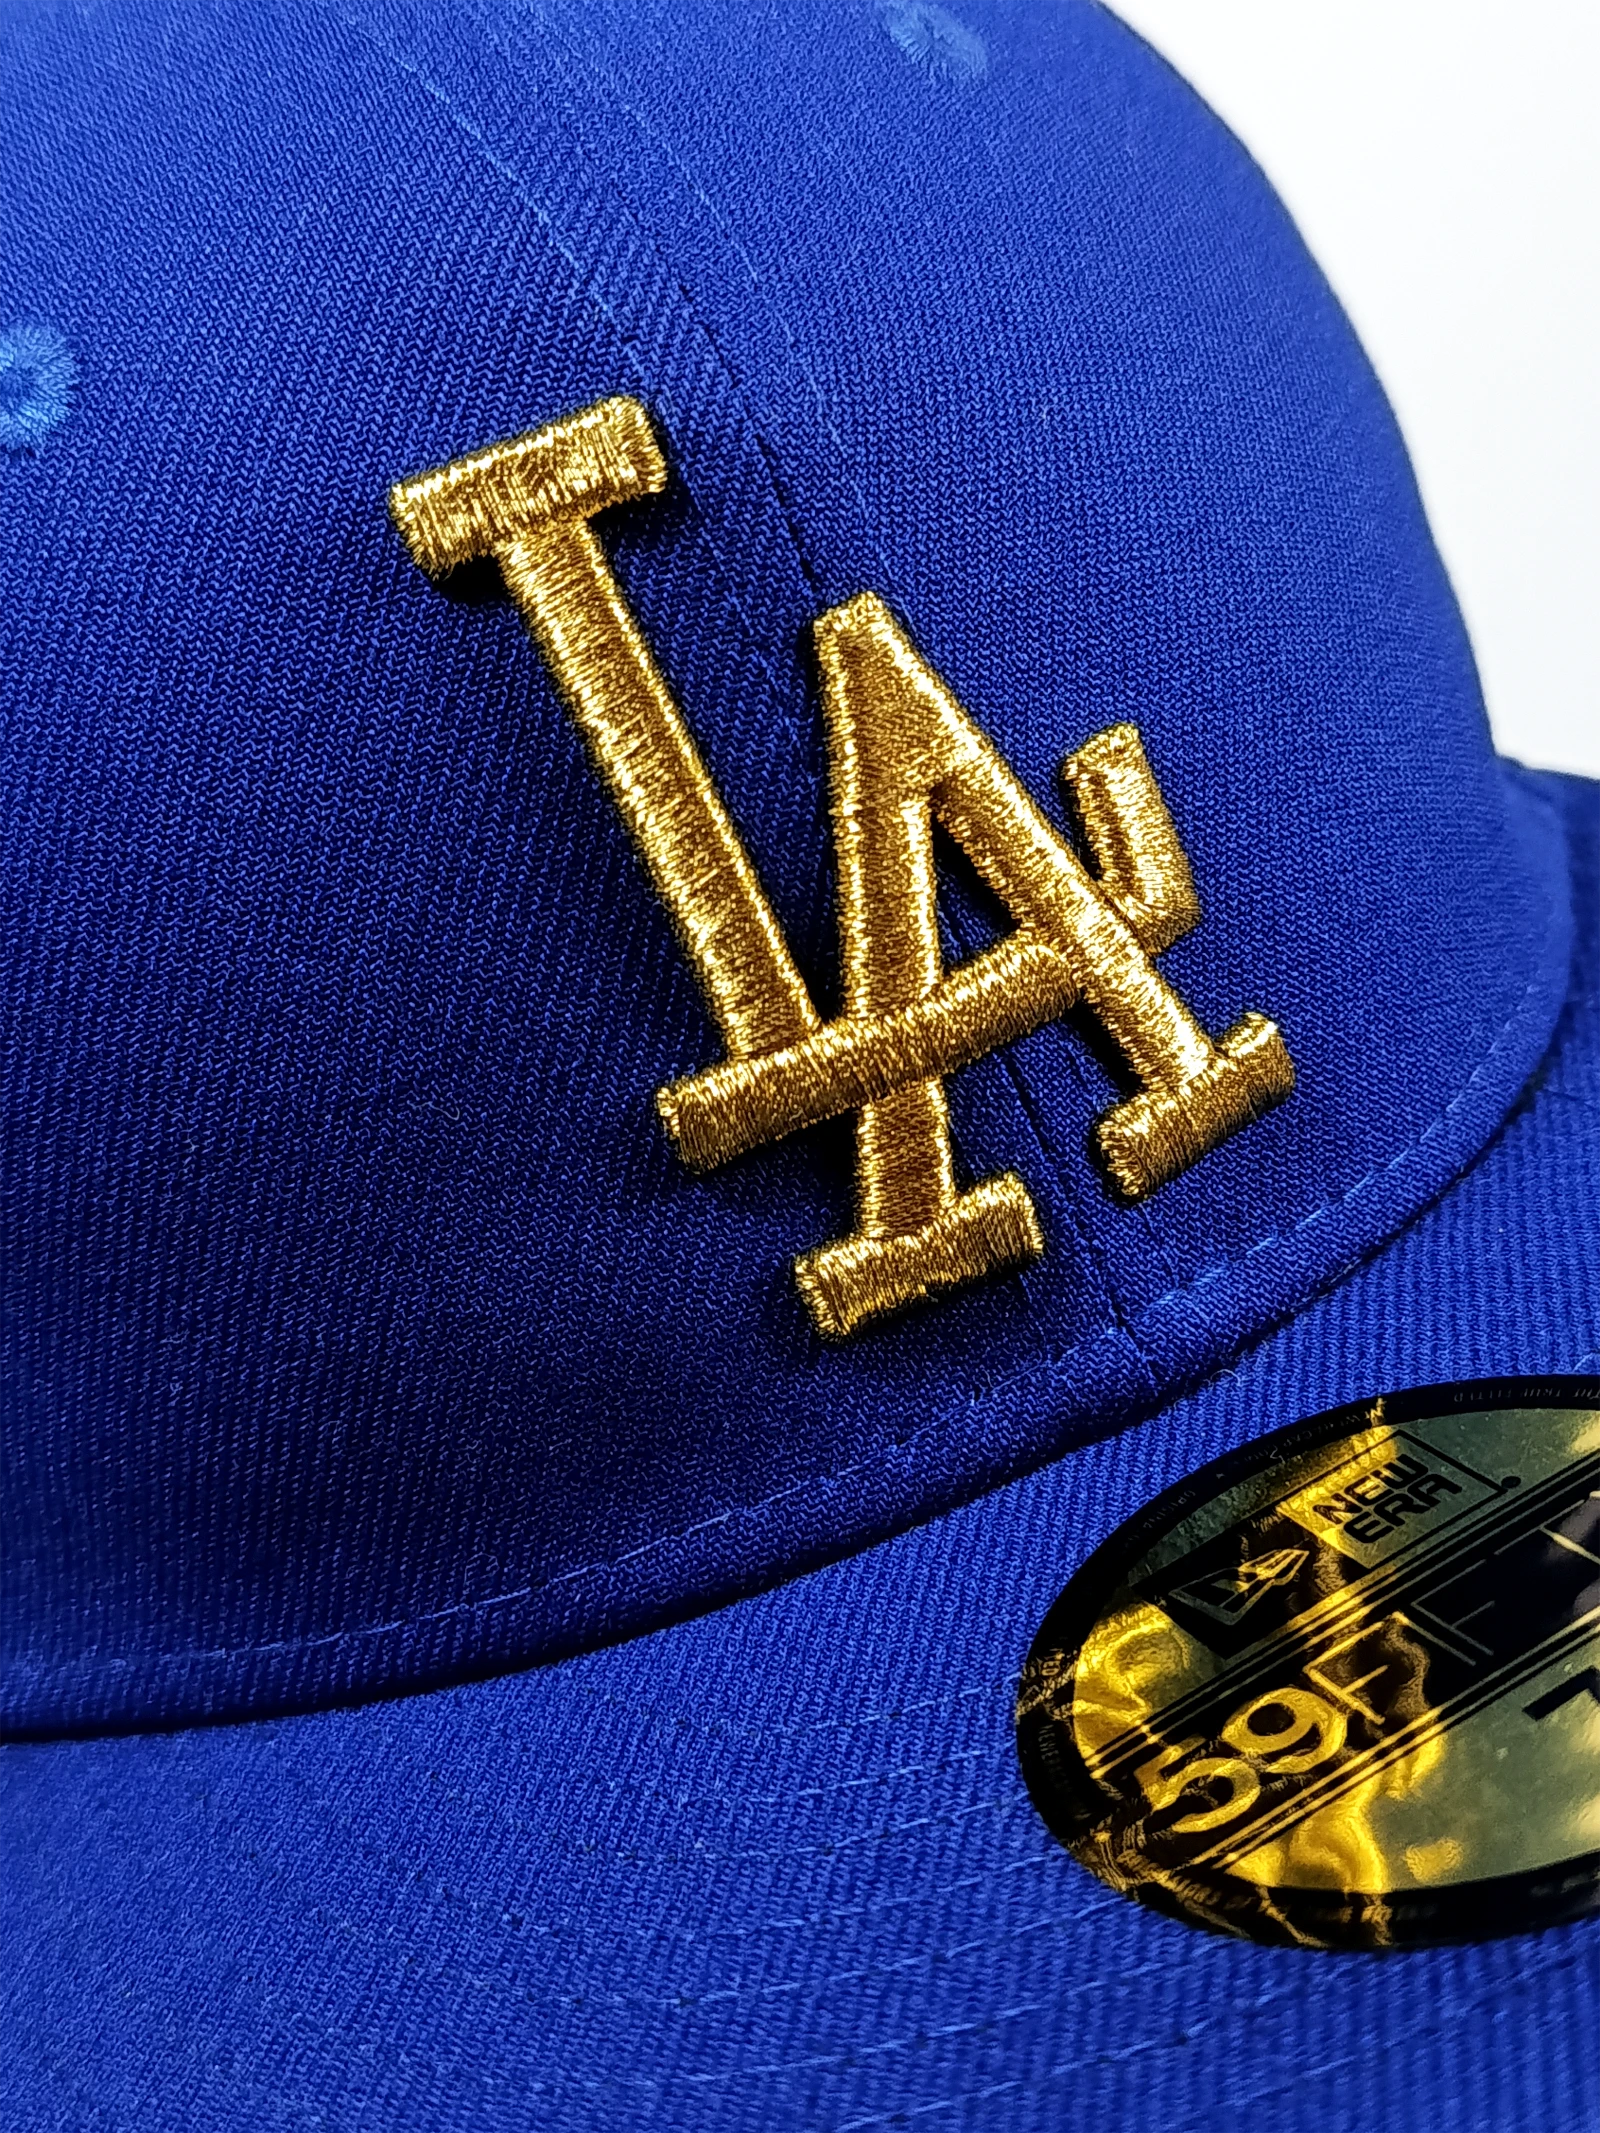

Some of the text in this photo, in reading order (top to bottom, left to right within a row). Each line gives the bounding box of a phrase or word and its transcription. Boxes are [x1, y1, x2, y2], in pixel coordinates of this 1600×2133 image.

[390, 395, 1294, 1338] LA
[1313, 1455, 1428, 1525] NEW
[1345, 1472, 1462, 1543] ERA
